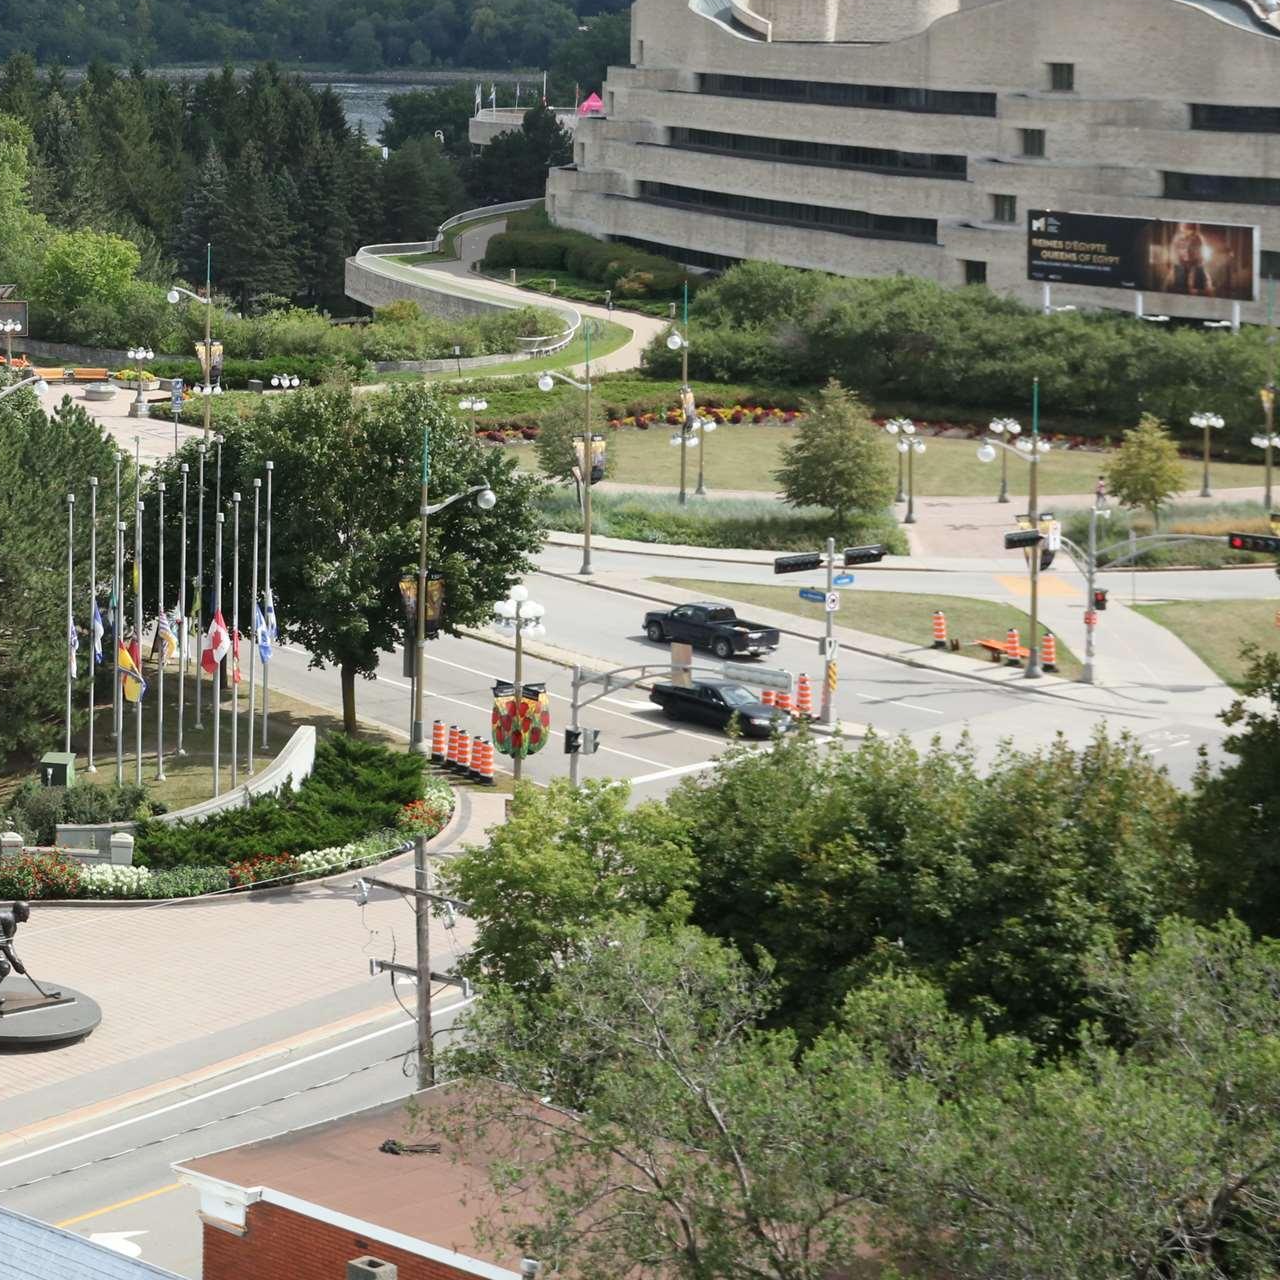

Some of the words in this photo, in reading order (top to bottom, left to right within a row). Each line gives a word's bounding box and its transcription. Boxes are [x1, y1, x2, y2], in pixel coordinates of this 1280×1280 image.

[1040, 250, 1077, 262] QUEENS
[1078, 254, 1091, 263] OF
[1092, 255, 1121, 265] EGYPT
